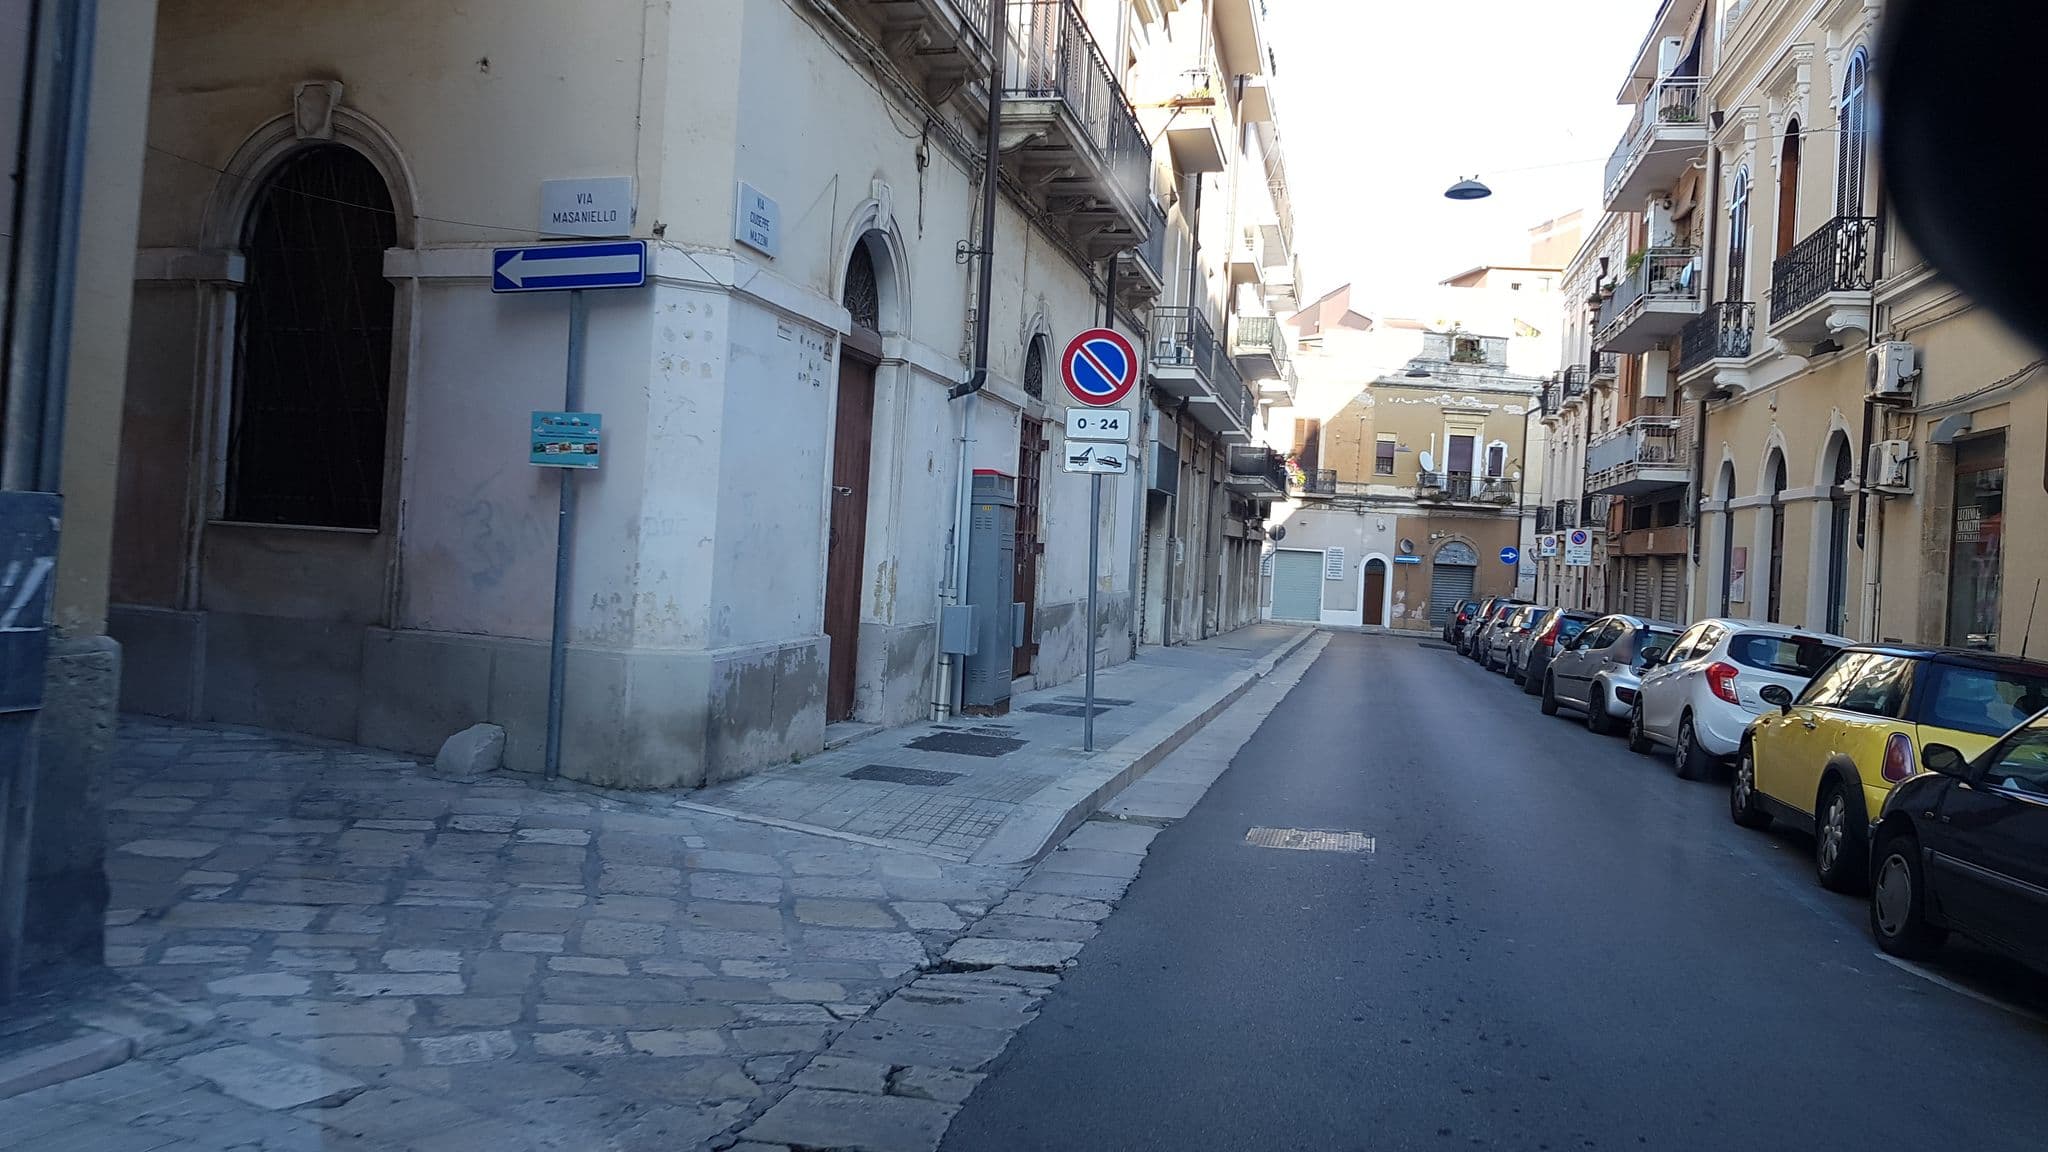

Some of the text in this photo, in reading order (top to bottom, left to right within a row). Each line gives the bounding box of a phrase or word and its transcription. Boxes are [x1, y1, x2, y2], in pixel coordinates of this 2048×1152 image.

[576, 192, 593, 205] VIA
[757, 197, 766, 210] VIA
[552, 209, 617, 224] MASANIELLO
[1077, 417, 1087, 430] 0
[1099, 418, 1119, 430] 24
